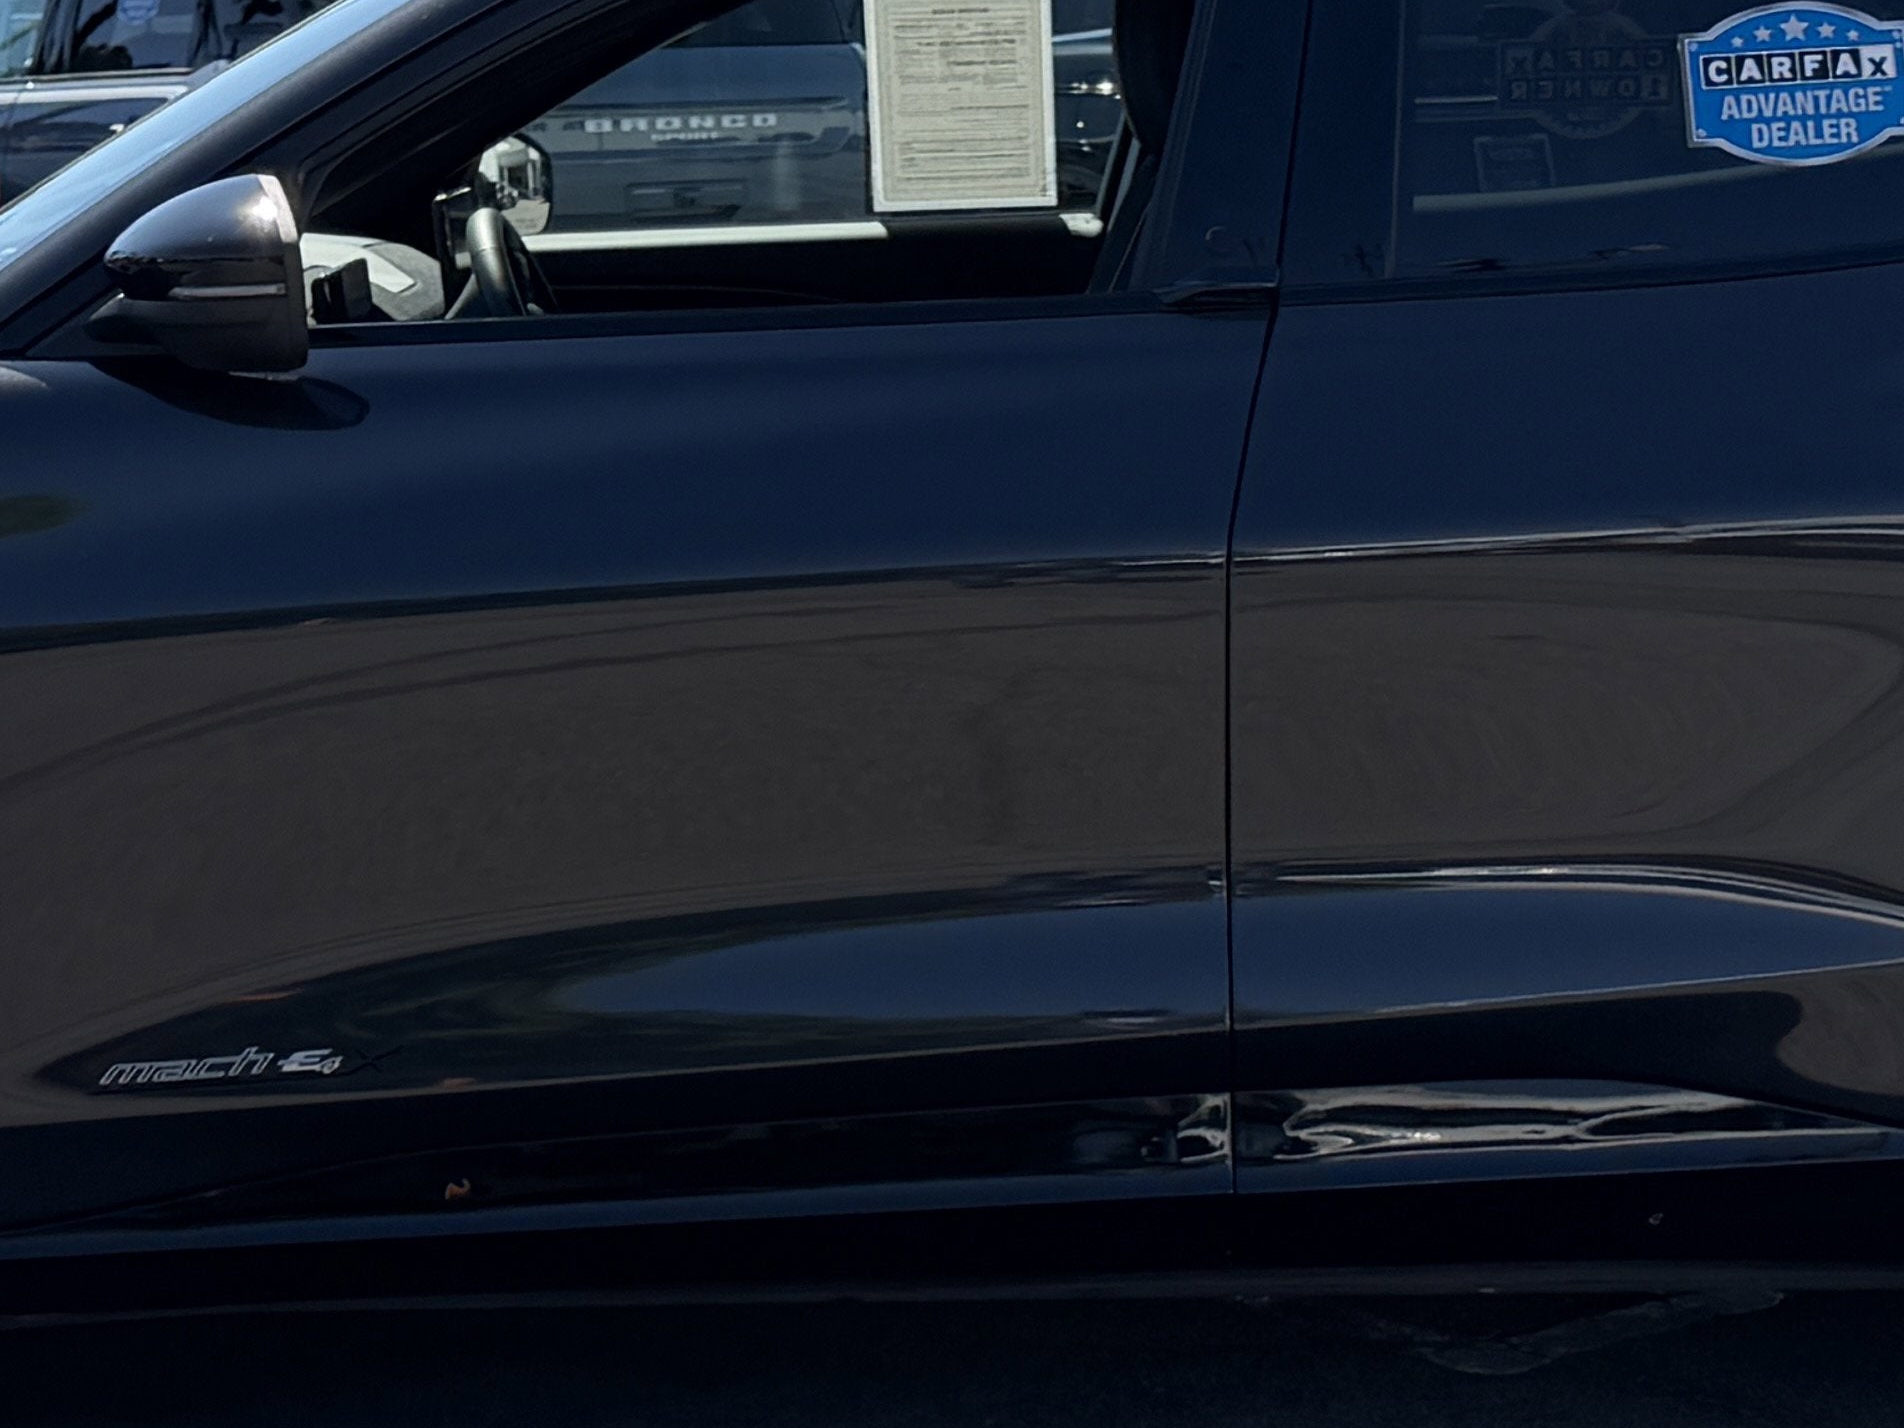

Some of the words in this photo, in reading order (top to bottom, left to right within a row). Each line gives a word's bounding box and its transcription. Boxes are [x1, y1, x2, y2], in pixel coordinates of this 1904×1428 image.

[1704, 48, 1893, 87] CARFAX
[1720, 85, 1885, 121] ADVANTAGE
[583, 113, 777, 134] BRONCO
[1751, 118, 1860, 149] DEALER
